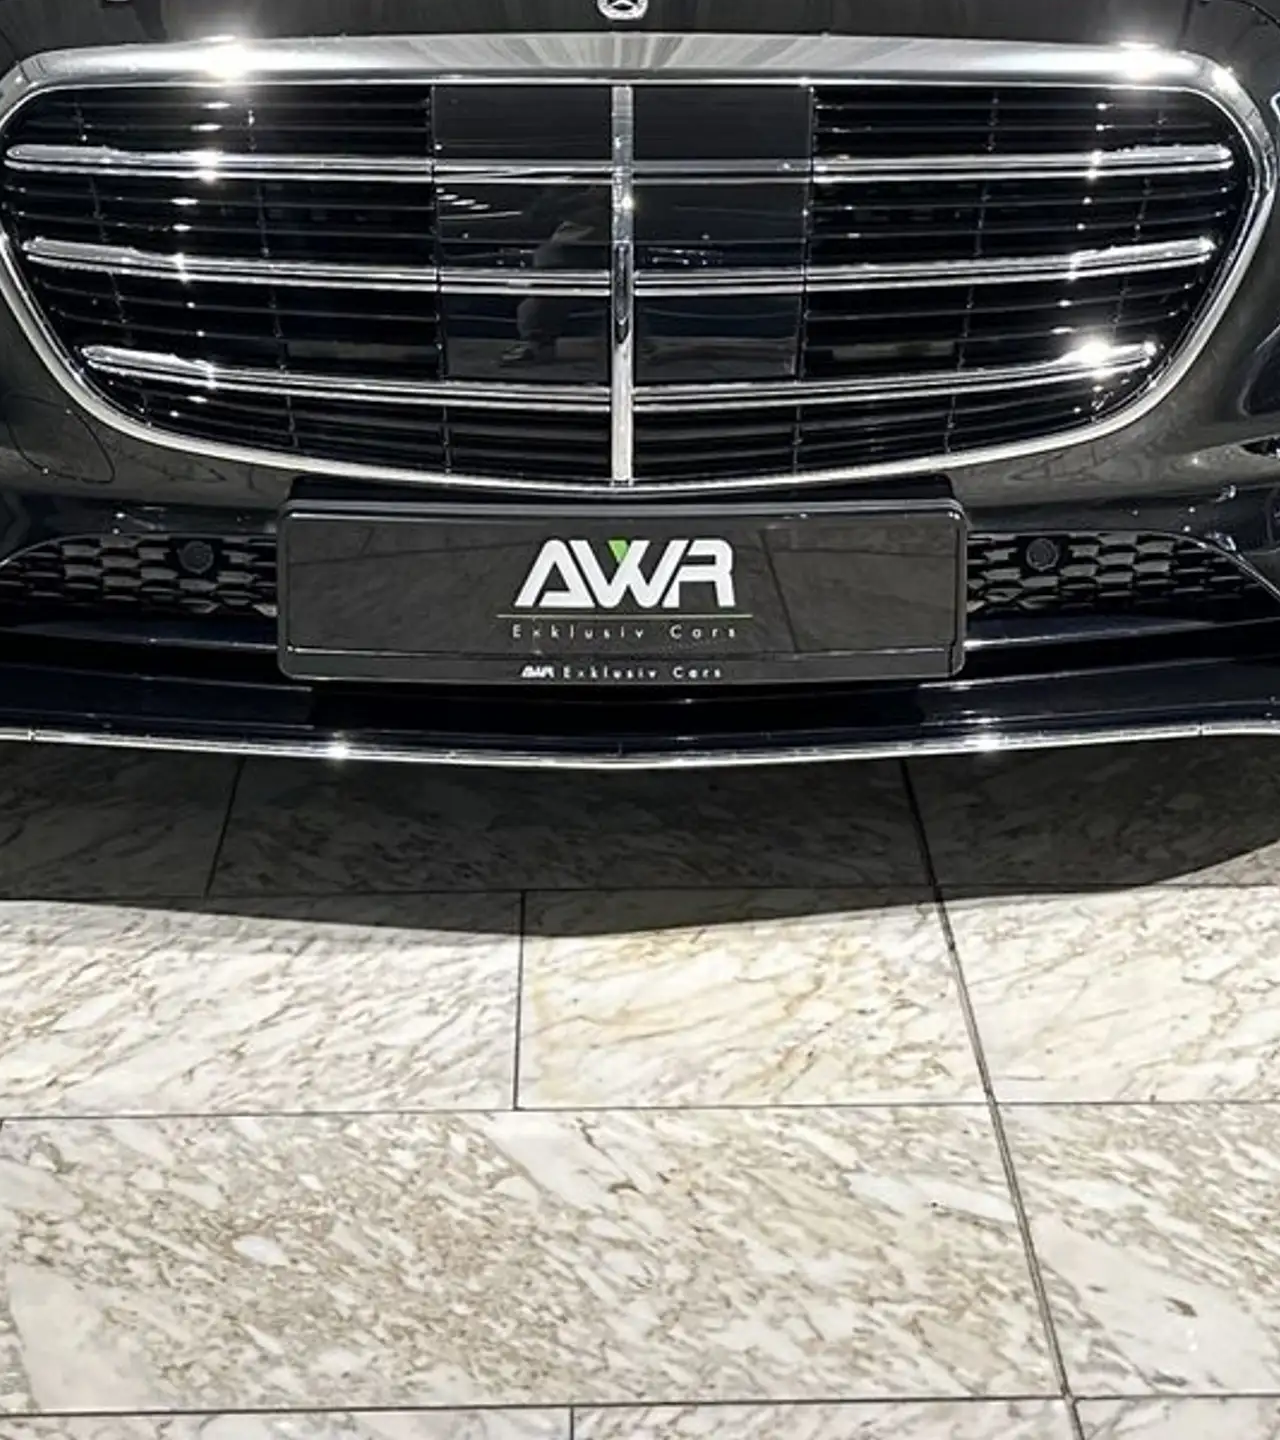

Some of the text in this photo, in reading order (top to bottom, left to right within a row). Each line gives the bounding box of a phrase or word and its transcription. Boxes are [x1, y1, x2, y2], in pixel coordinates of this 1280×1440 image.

[514, 539, 736, 608] AWR
[512, 624, 736, 639] Exklusiv Cars
[562, 664, 658, 678] Exklusiv
